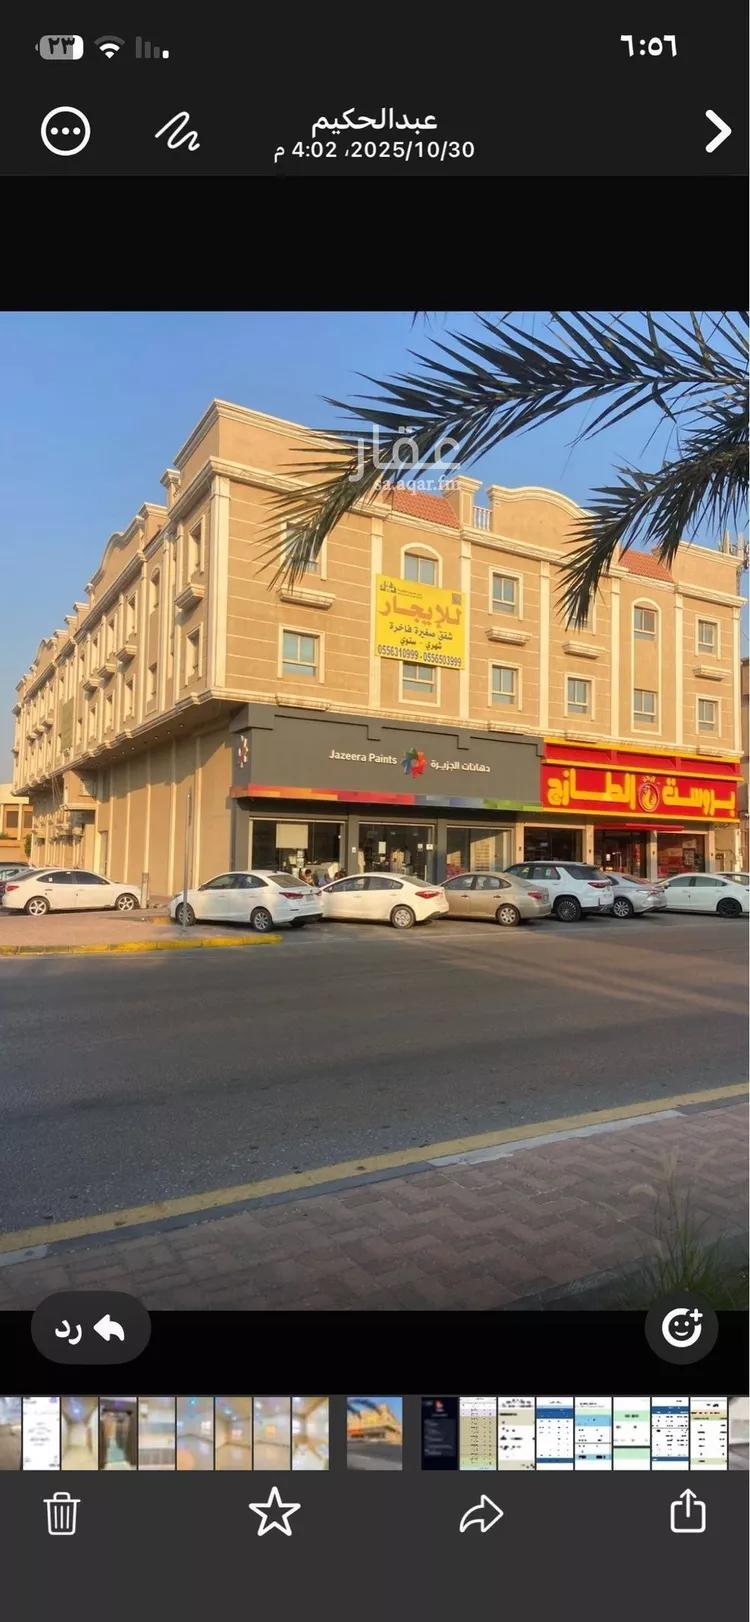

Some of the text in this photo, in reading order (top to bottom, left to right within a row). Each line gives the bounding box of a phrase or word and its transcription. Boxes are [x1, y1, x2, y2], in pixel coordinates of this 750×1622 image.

[48, 37, 76, 55] ٢٣
[620, 34, 677, 58] ٦:٥٦
[311, 107, 438, 138] عبدالحكيم
[273, 146, 285, 163] م
[291, 141, 338, 158] 4:02
[389, 621, 453, 641] شقق صغيرة فاخرة
[400, 636, 417, 646] سنوي
[425, 641, 442, 651] شهري
[378, 645, 418, 659] 0556310999
[423, 652, 461, 666] 0556503999
[329, 750, 397, 764] Jazeera Paints
[430, 760, 490, 772] دهانات الجزيرة
[547, 768, 736, 818] بروست الطازج
[54, 1319, 83, 1345] رد
